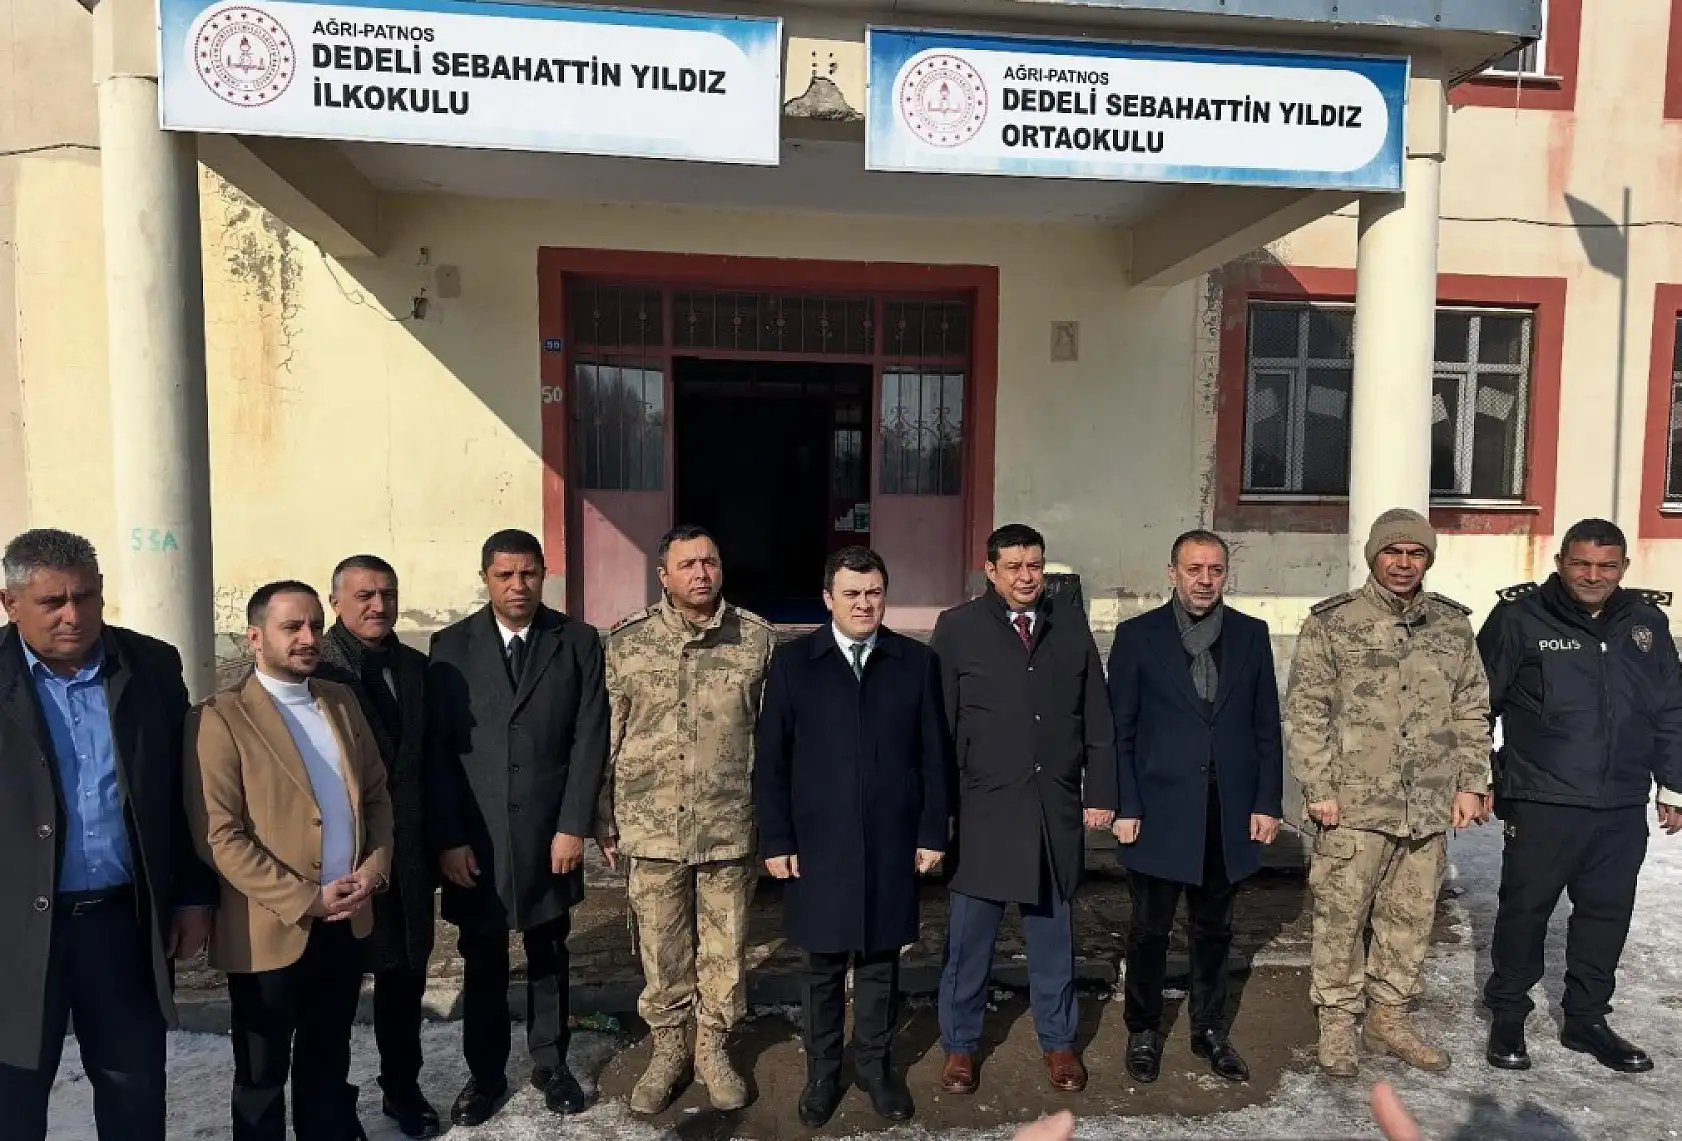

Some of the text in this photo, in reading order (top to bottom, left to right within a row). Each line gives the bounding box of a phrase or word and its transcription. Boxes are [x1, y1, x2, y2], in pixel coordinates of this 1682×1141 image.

[312, 18, 435, 43] AĞRI-PATNOS
[312, 43, 422, 75] DEDELİ
[432, 51, 621, 87] SEBAHATTİN
[630, 64, 726, 94] YILDIZ
[1003, 64, 1109, 86] AĞRI-PATNOS
[313, 77, 469, 116] İLKOKULU
[1002, 87, 1097, 116] DEDELİ
[1105, 94, 1271, 124] SEBAHATTİN
[1279, 102, 1362, 128] YILDIZ
[1001, 124, 1164, 154] ORTAOKULU
[541, 385, 563, 403] 50
